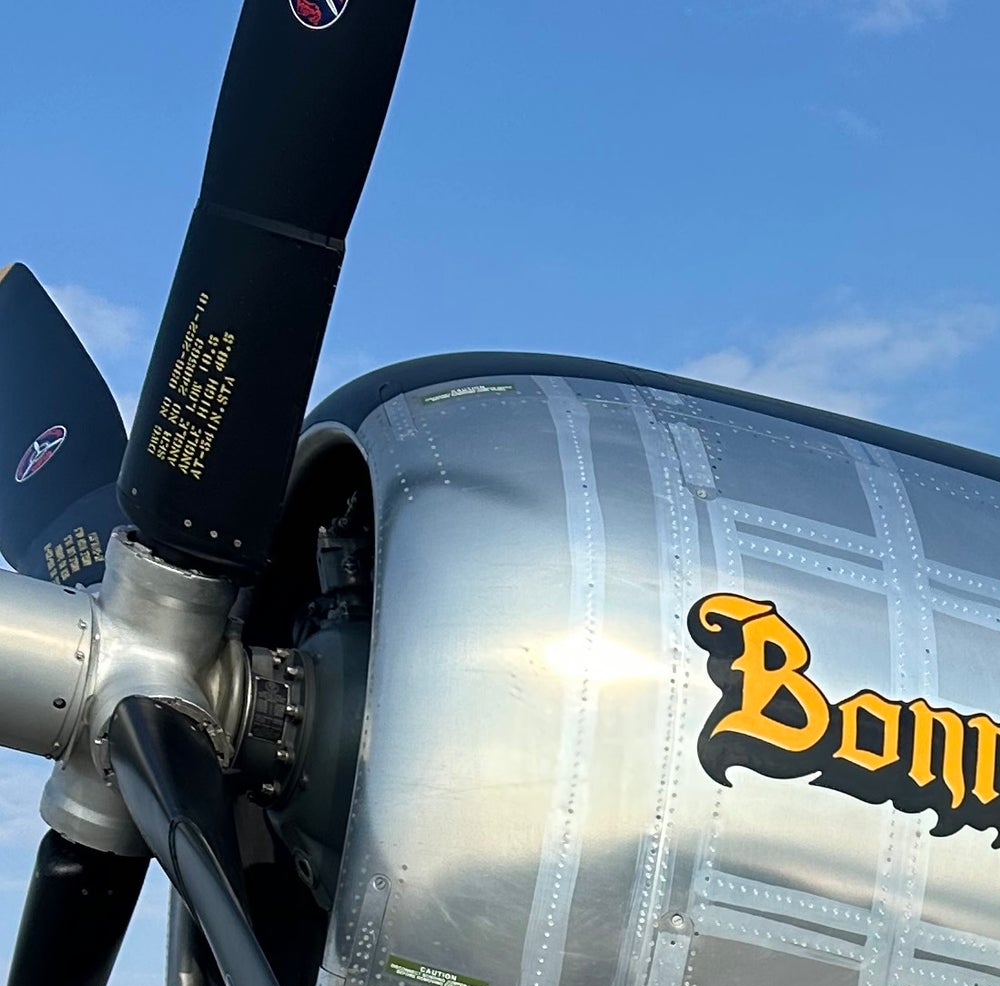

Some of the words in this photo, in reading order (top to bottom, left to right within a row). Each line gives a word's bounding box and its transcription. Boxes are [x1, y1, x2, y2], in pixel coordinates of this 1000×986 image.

[159, 396, 172, 418] NO
[168, 403, 181, 424] NO
[167, 417, 190, 467] ANGLE
[185, 381, 203, 412] LOW
[178, 425, 202, 474] ANGLE
[196, 378, 219, 419] HIGH
[420, 966, 457, 981] CAUTION
